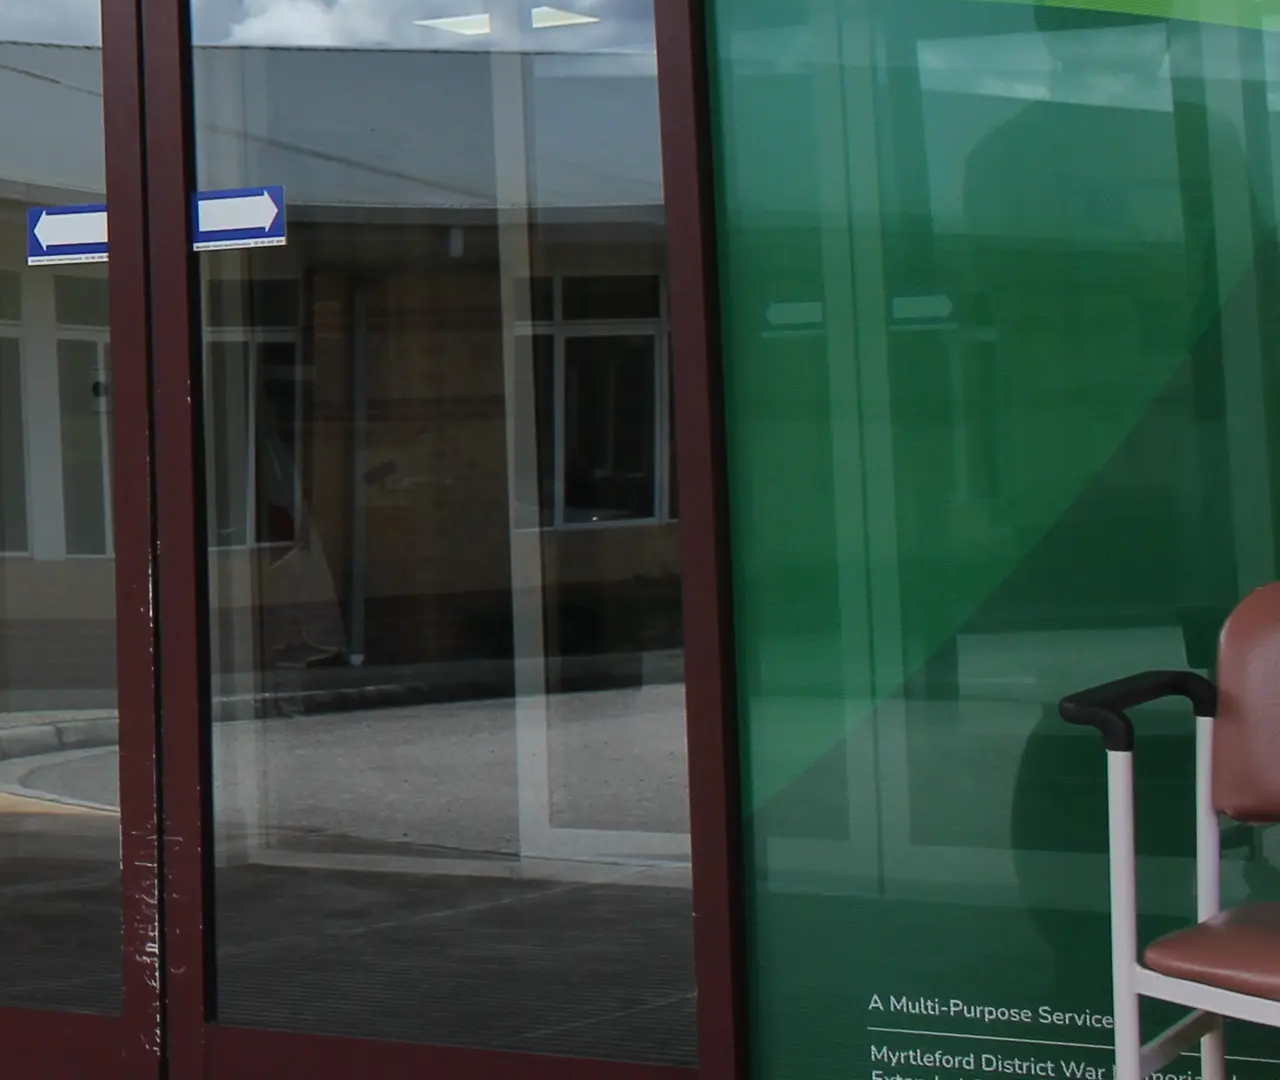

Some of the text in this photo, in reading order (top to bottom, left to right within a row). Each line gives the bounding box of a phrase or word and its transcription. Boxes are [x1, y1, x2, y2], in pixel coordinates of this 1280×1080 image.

[868, 993, 1114, 1028] A Multi-Purpose Service
[870, 1044, 975, 1070] Myrtleford
[981, 1053, 1056, 1077] District
[1060, 1059, 1106, 1080] War
